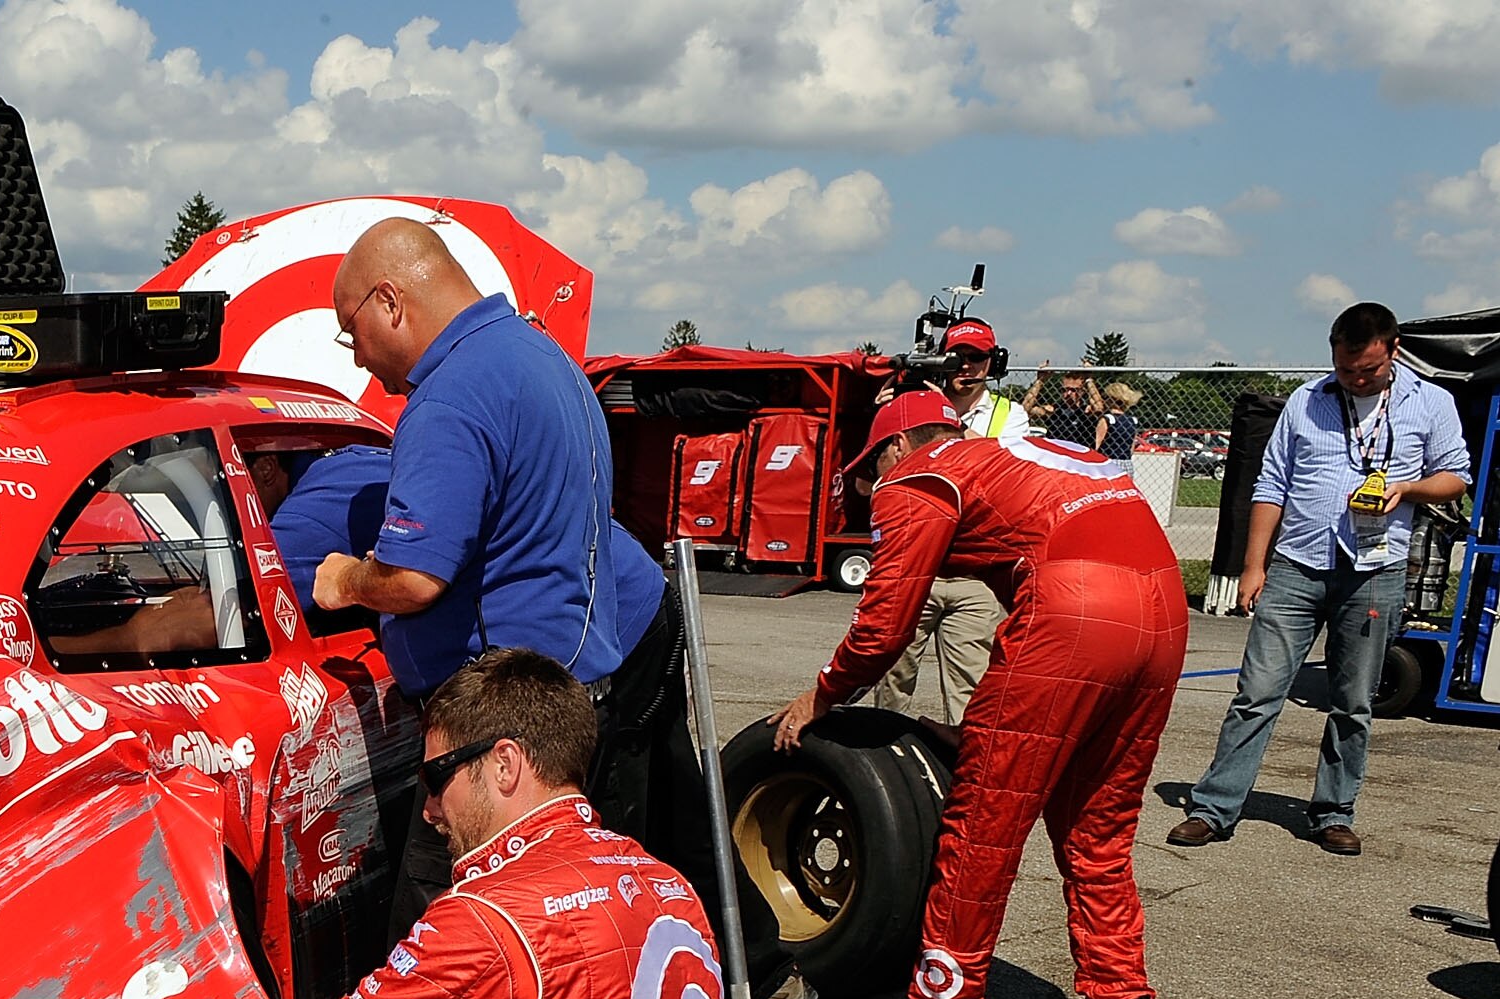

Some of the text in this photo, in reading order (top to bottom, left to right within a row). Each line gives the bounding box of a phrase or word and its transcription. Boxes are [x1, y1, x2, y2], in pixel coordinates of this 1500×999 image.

[765, 446, 802, 470] 9
[690, 461, 723, 485] 9
[3, 637, 31, 662] Shops
[312, 862, 356, 903] Macaroni
[543, 886, 612, 916] Energizer
